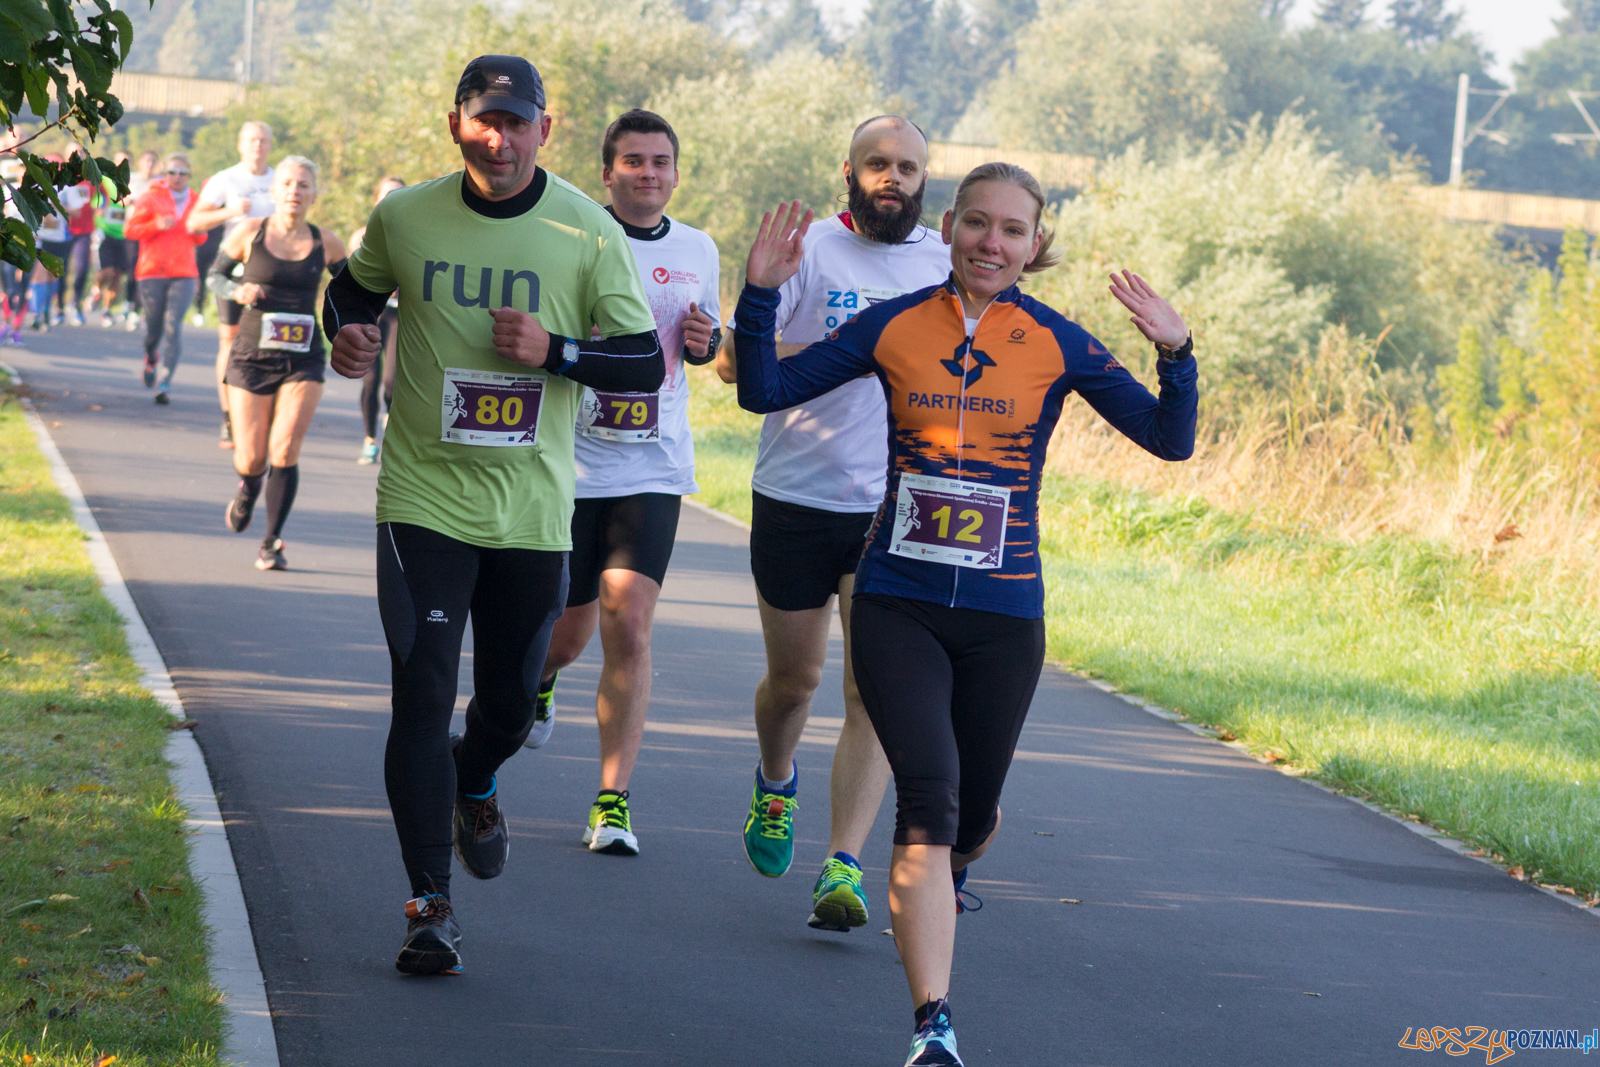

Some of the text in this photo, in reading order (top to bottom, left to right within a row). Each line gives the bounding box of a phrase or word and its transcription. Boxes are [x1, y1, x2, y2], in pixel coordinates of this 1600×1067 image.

[422, 260, 540, 313] run
[670, 270, 697, 279] CHALLENGE
[280, 325, 304, 342] 13
[475, 394, 524, 426] 80
[610, 400, 648, 426] 79
[908, 392, 1007, 415] PARTNERS
[1007, 398, 1016, 419] TEAM
[931, 505, 984, 544] 12
